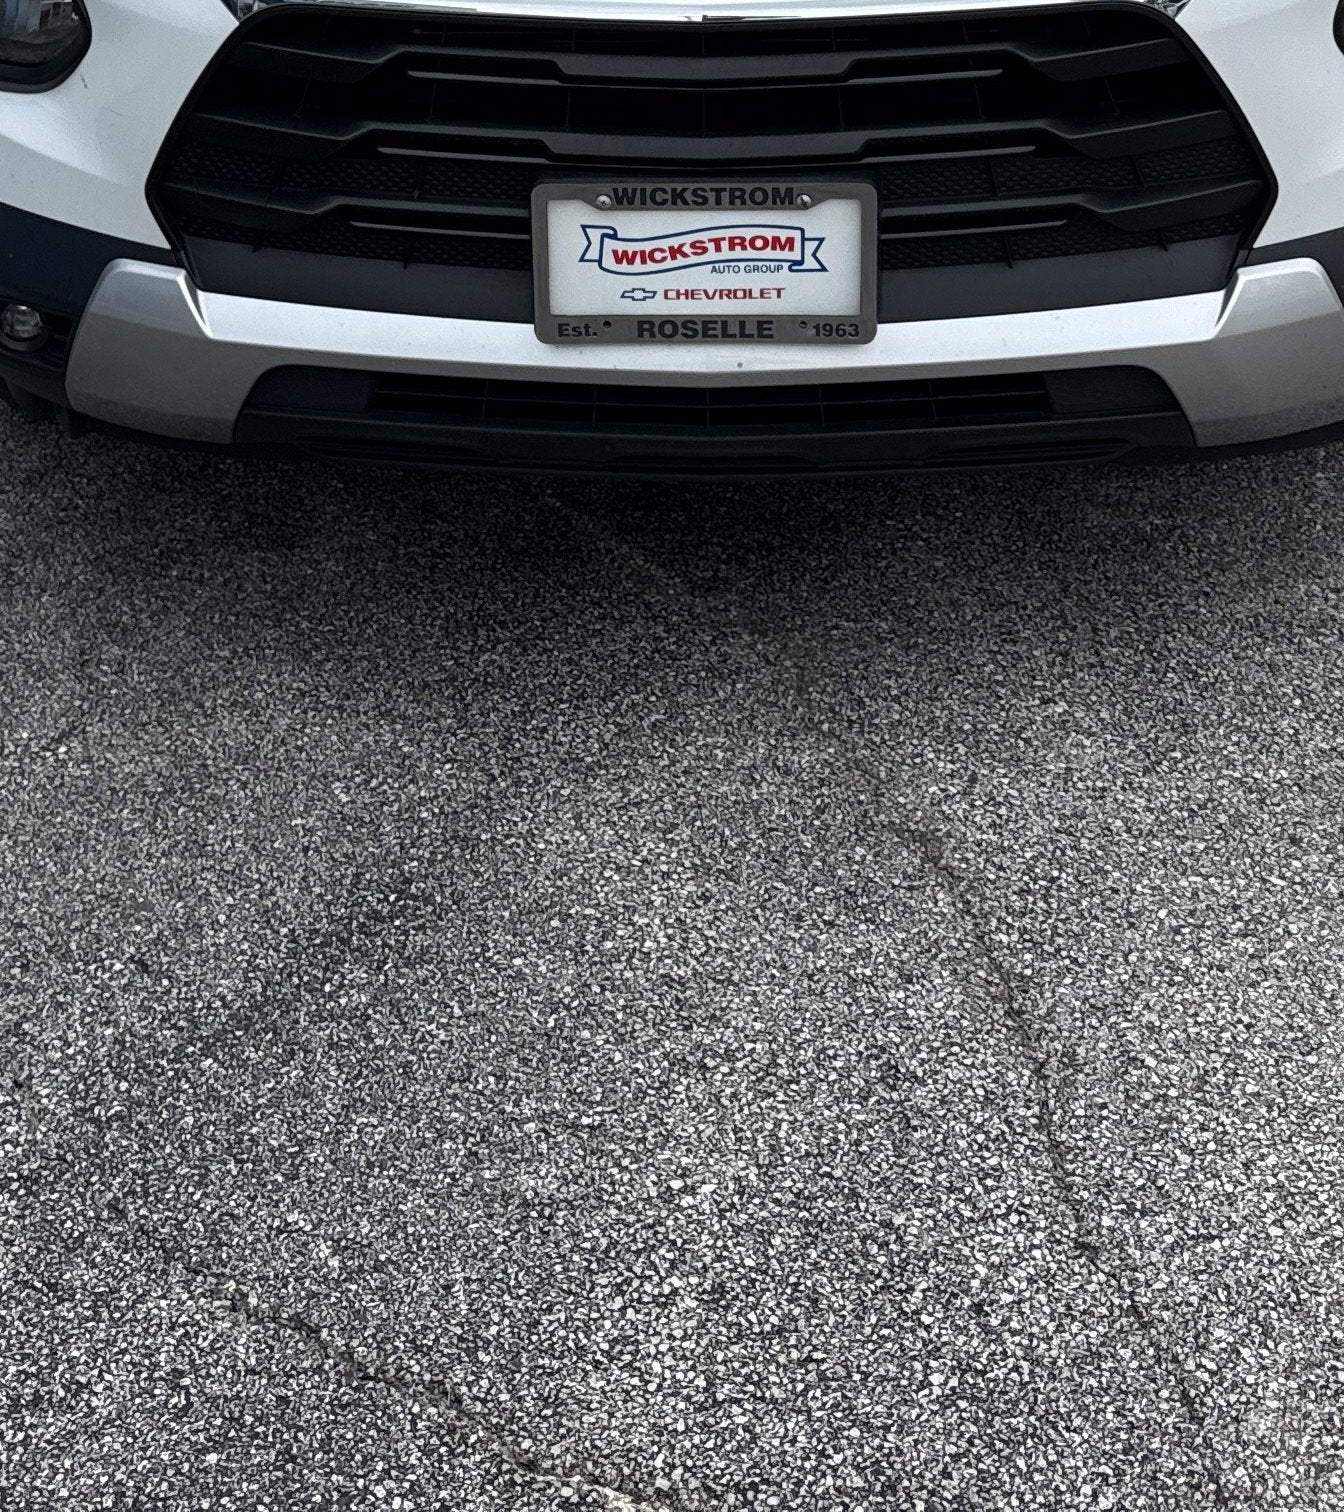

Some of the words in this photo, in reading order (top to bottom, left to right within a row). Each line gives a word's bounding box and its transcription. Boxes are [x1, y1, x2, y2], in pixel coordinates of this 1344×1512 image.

[611, 186, 794, 207] WICKSTROM
[611, 234, 796, 265] WICKSTROM
[710, 264, 741, 274] AUTO
[743, 264, 784, 274] GROUP
[663, 287, 786, 301] CHEVROLET
[557, 322, 598, 337] Est.
[637, 319, 775, 339] ROSELLE
[812, 322, 860, 338] 1963
